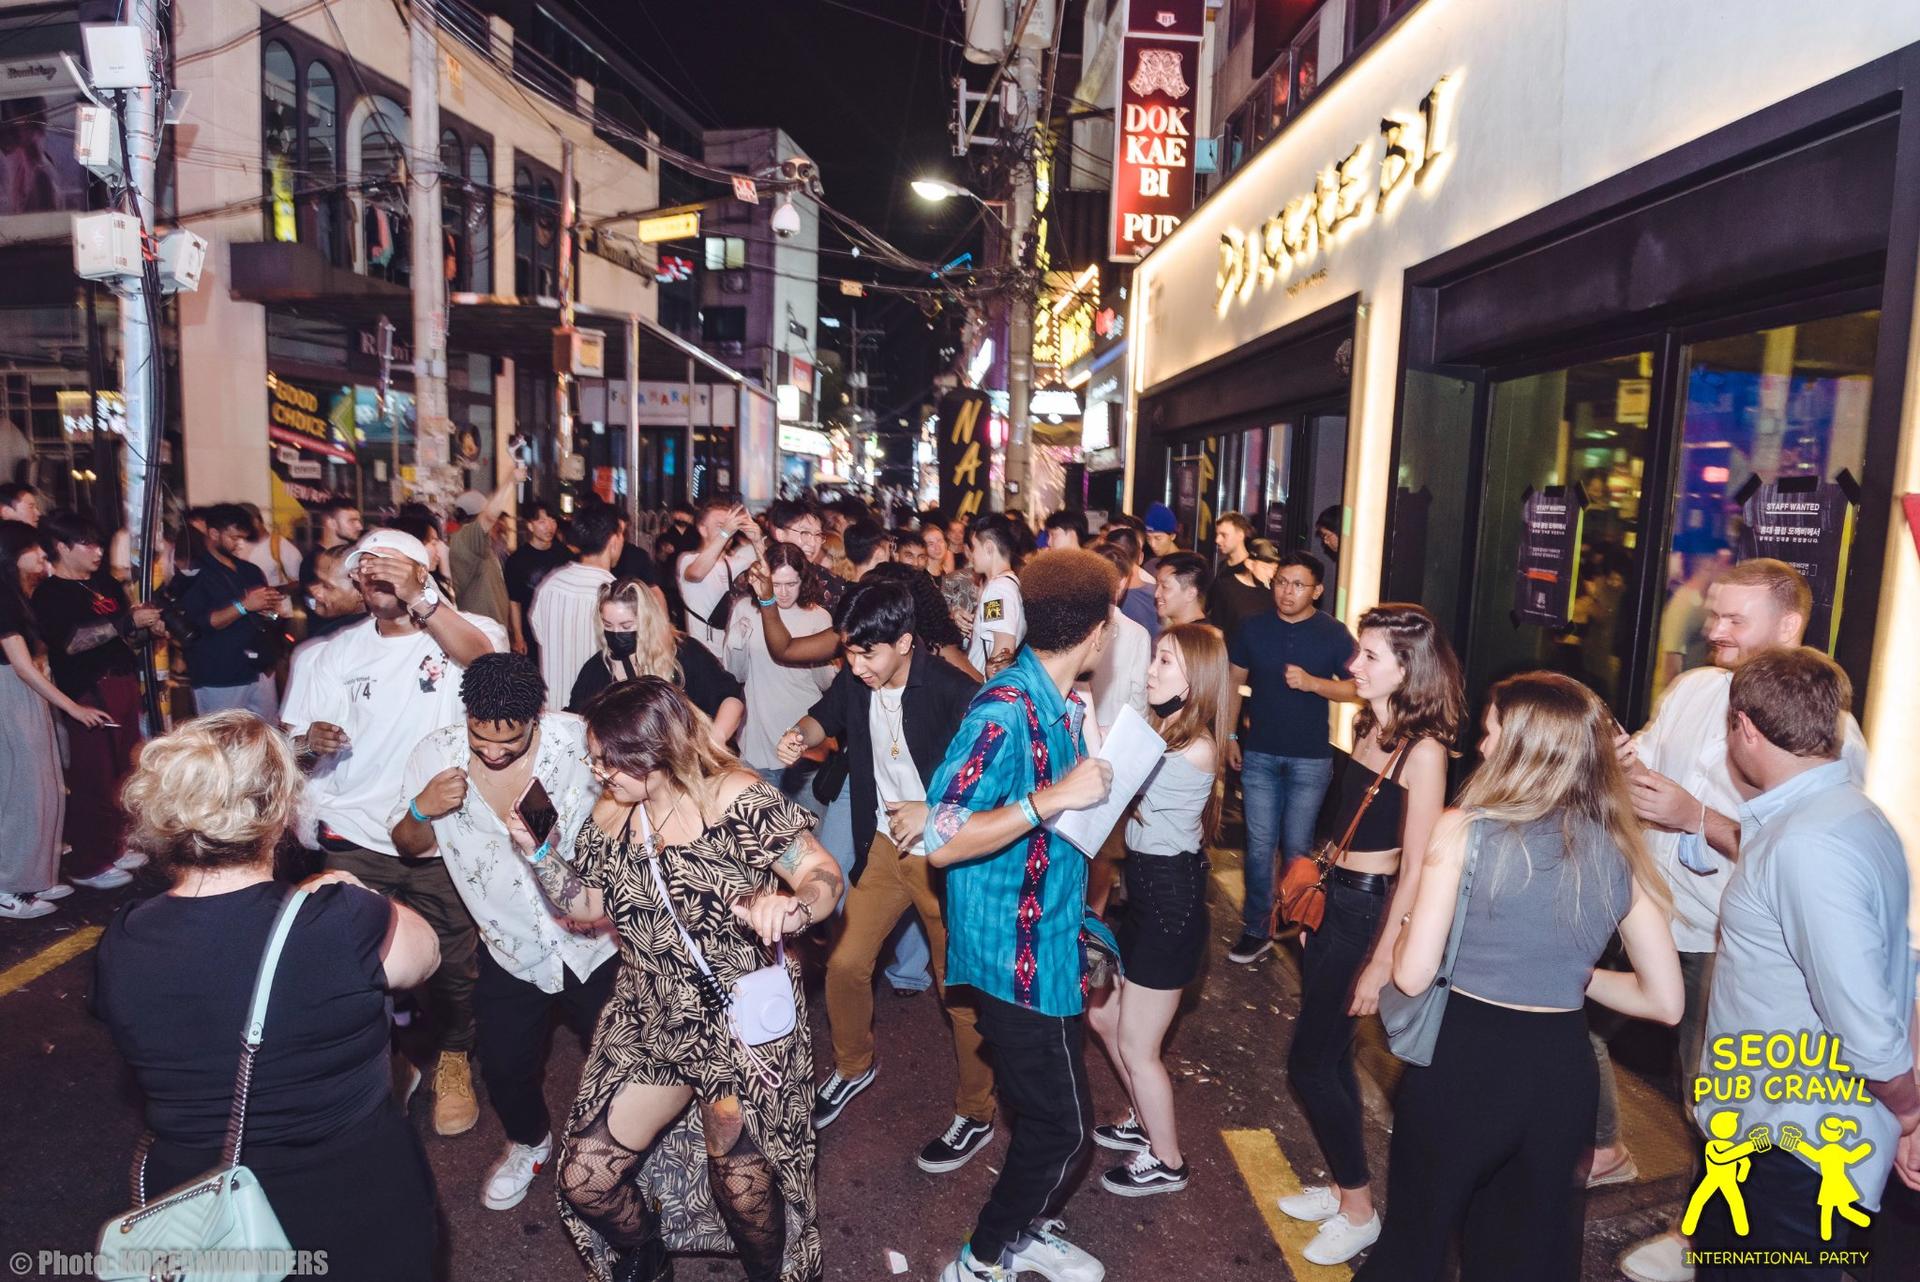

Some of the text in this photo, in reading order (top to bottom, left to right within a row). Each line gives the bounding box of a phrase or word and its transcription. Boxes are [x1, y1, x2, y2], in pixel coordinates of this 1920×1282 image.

[1124, 103, 1190, 136] DOK
[1126, 134, 1187, 167] KAE
[1139, 167, 1170, 198] BI
[275, 380, 318, 413] GOOD
[272, 402, 327, 439] CHOICE
[1766, 503, 1820, 511] STAFF WANTED
